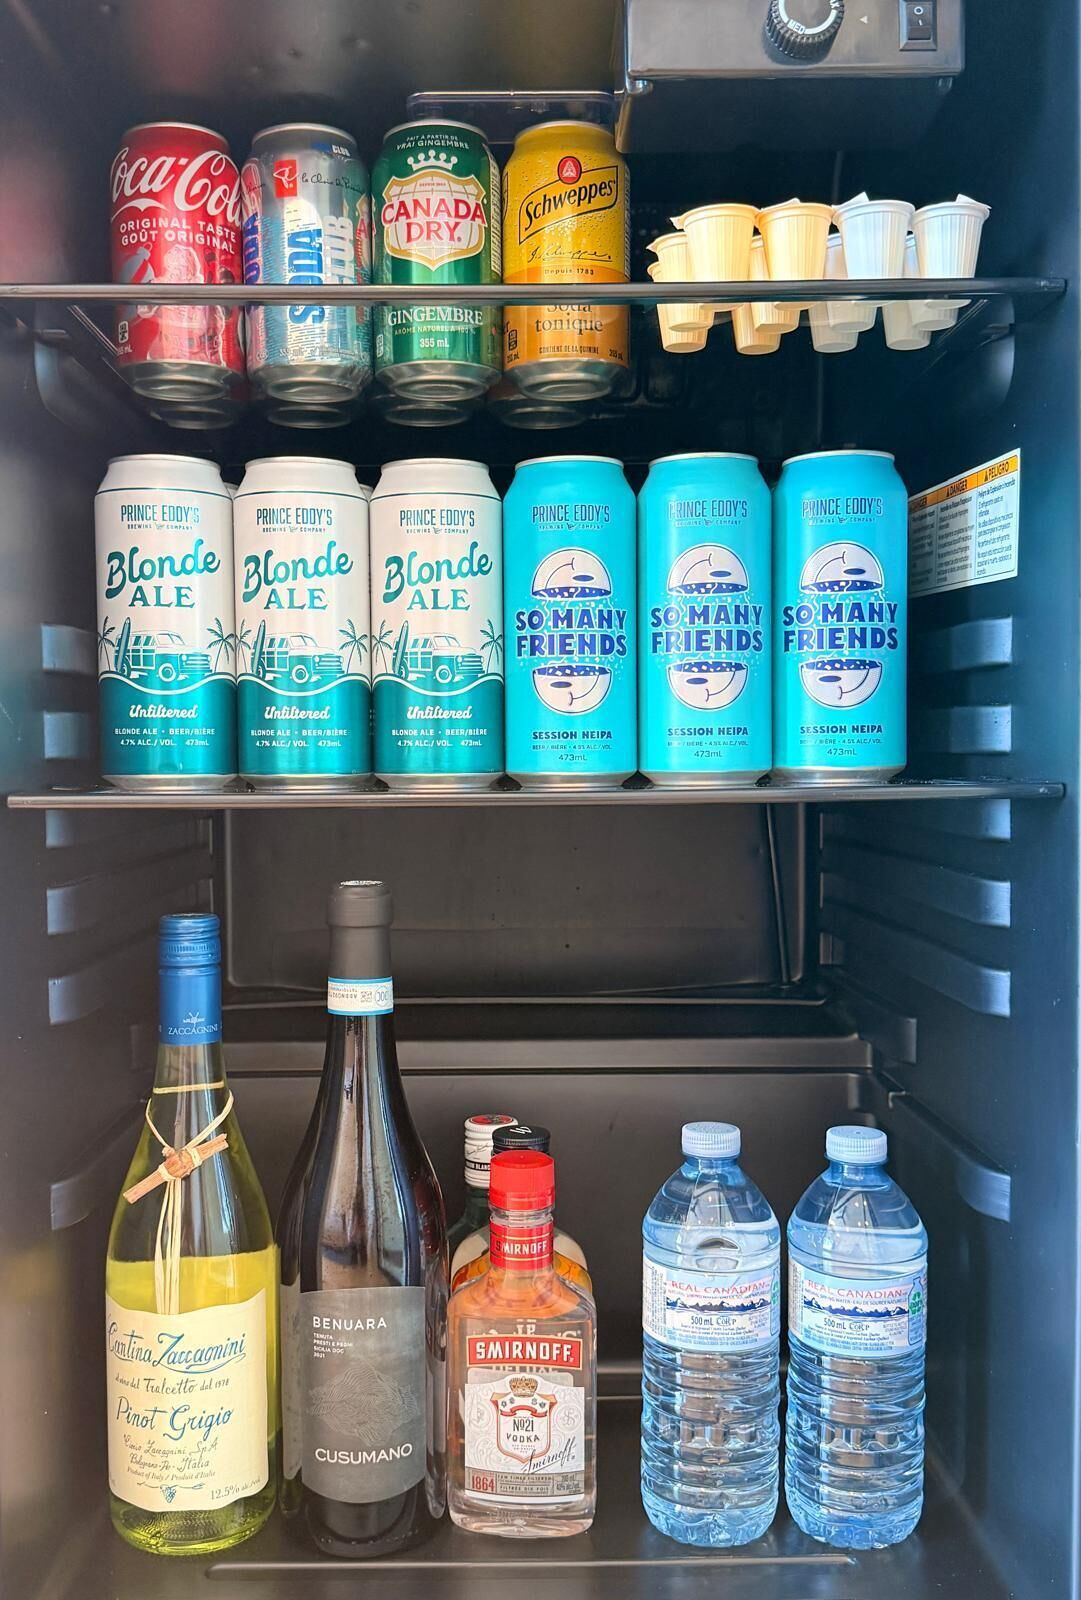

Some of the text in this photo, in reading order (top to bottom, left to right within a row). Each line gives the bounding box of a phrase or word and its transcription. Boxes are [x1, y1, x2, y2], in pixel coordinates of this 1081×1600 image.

[787, 19, 806, 34] MED
[397, 139, 470, 151] VRAI GINGEMBRE
[383, 198, 487, 224] CANADA
[524, 180, 615, 232] Schweppes
[120, 217, 236, 243] ORIGINAL TASTE
[405, 220, 460, 245] DRY
[121, 229, 236, 254] GOÛT ORIGINAL
[576, 267, 595, 276] 1783
[388, 306, 484, 326] GINGEMBRE
[535, 312, 604, 336] tonique
[420, 338, 450, 348] 355 mL
[987, 462, 1010, 481] PELIGRO
[120, 504, 201, 523] PRINCE EDDY'S
[532, 504, 611, 523] PRINCE EDDY'S
[669, 500, 748, 518] PRINCE EDDY'S
[803, 498, 882, 517] PRINCE EDDY'S
[256, 508, 333, 526] PRINCE EDDY'S
[399, 509, 475, 527] PRINCE EDDY'S
[105, 538, 220, 599] Blonde
[241, 540, 353, 603] Blonde
[382, 541, 493, 604] Blonde
[128, 585, 196, 608] ALE
[263, 587, 328, 610] ALE
[406, 588, 471, 611] ALE
[516, 608, 628, 631] SO MANY
[650, 604, 763, 627] SO MANY
[782, 602, 899, 627] SO MANY
[516, 634, 628, 658] FRIENDS
[651, 629, 763, 655] FRIENDS
[783, 626, 899, 653] FRIENDS
[129, 704, 199, 719] Unfiltered
[263, 705, 331, 720] Unfiltered
[406, 705, 473, 720] Unfiltered
[169, 727, 216, 736] BEER/BIÈRE
[302, 729, 348, 737] BEER/BIÈRE
[445, 728, 488, 737] BEER/BIÈRE
[532, 731, 613, 740] SESSION NEIPA
[668, 727, 750, 736] SESSION NEIPA
[800, 725, 884, 734] SESSION NEIPA
[694, 750, 723, 758] 473mL
[827, 748, 857, 756] 473mL
[168, 1024, 218, 1036] ZACCAGNINI
[495, 1241, 548, 1256] SMIRNOFF
[670, 1280, 699, 1292] REAL
[704, 1281, 766, 1295] CANADIAN
[808, 1280, 834, 1295] REAL
[837, 1288, 903, 1300] CANADIAN
[312, 1315, 387, 1332] BENUARA
[691, 1315, 714, 1326] 500 mL
[824, 1317, 847, 1330] 500 mL
[109, 1321, 246, 1373] Cantina Zaccagnini
[475, 1341, 573, 1363] SMIRNOFF
[143, 1378, 197, 1395] Tralcetto
[116, 1396, 169, 1430] Pinot
[163, 1404, 234, 1442] Grigio
[506, 1432, 541, 1443] VODKA
[315, 1443, 413, 1464] CUSUMANO
[211, 1484, 240, 1500] 12.5%
[471, 1475, 495, 1492] 1864
